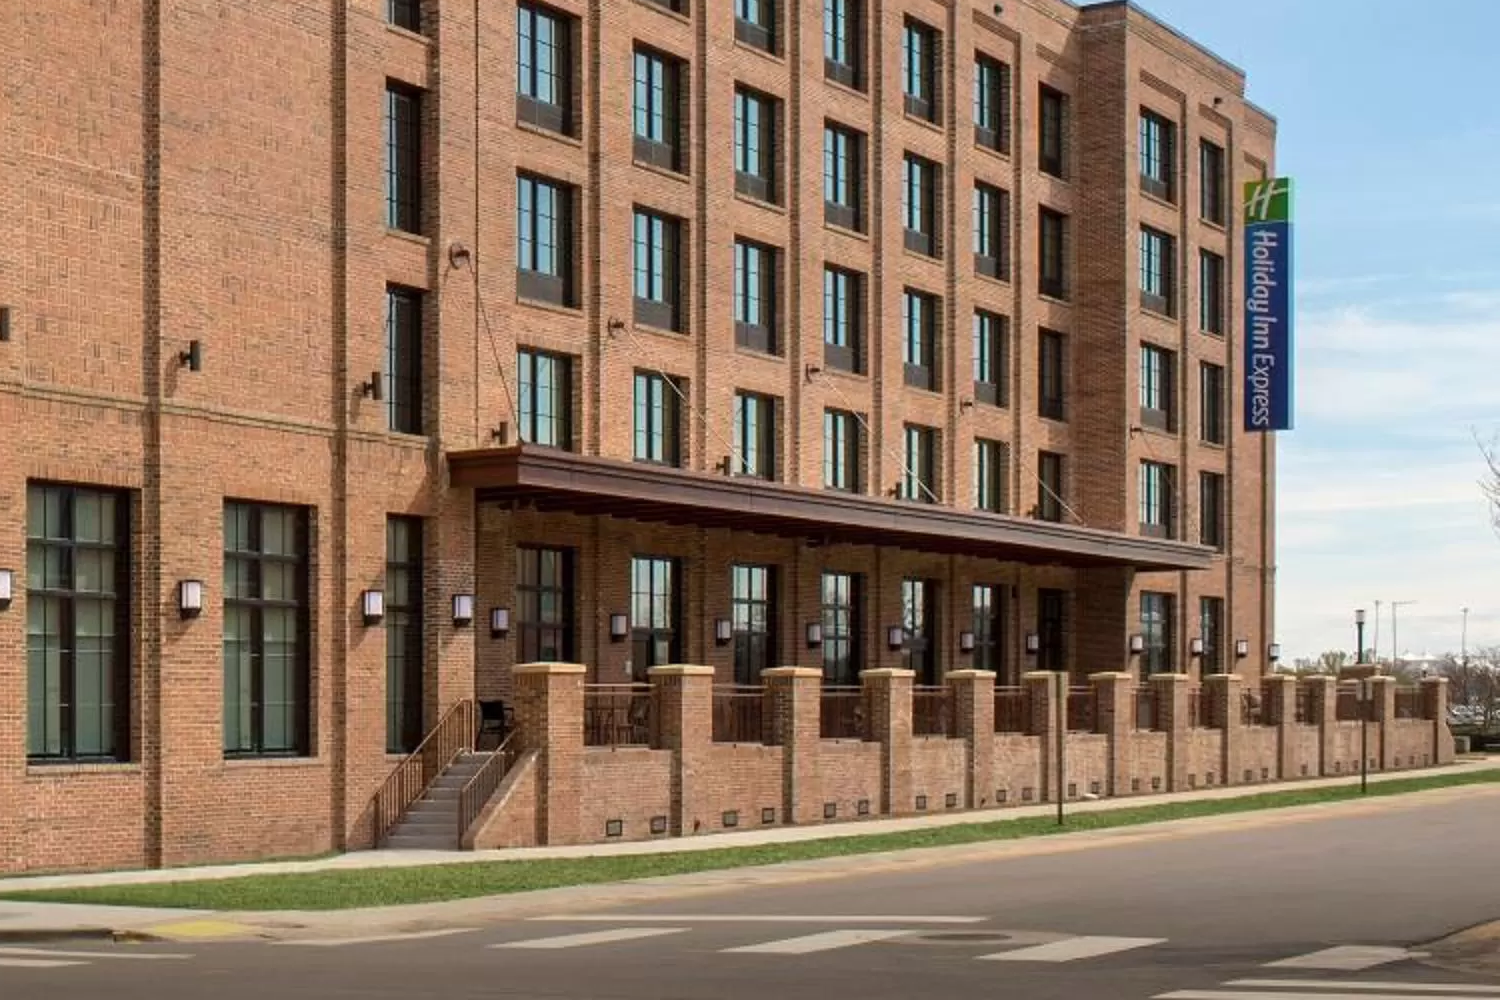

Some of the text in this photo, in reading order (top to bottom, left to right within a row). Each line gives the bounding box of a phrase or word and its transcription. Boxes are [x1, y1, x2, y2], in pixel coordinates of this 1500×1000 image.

[1247, 229, 1278, 426] Holiday Inn Express
